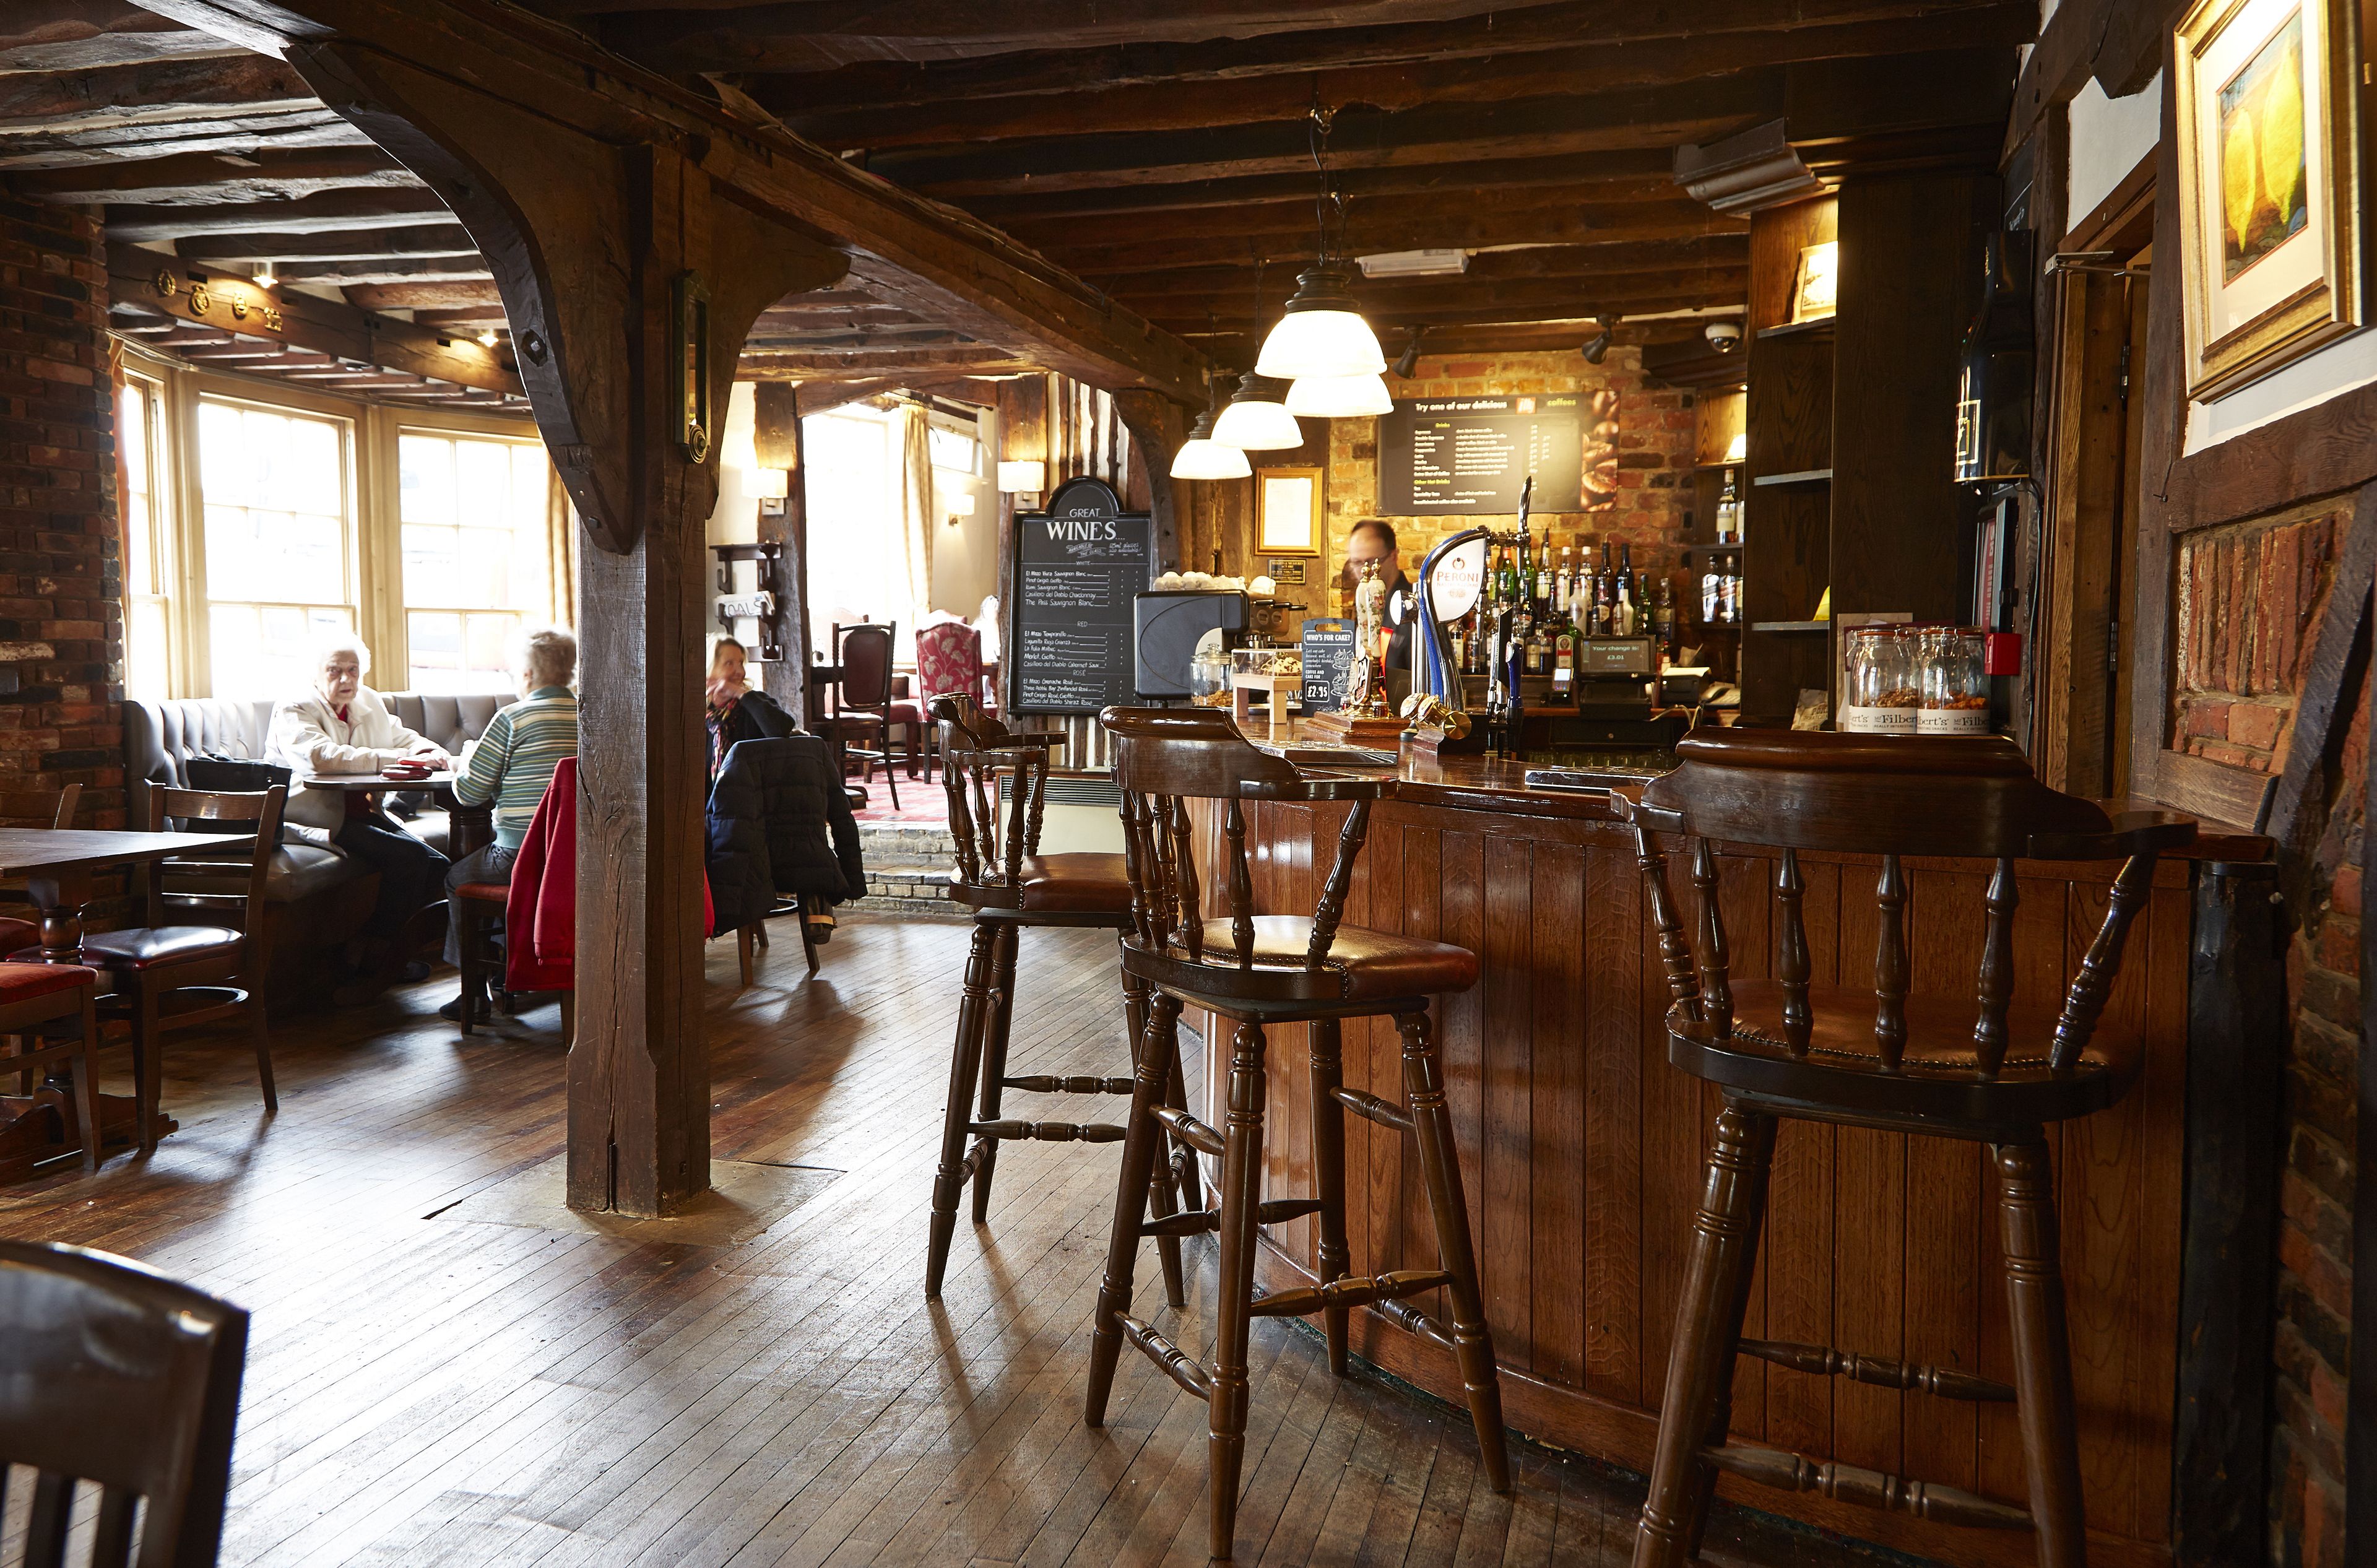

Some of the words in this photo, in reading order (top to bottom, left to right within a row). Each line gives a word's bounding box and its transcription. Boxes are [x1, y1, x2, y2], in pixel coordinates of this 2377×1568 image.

[1415, 403, 1428, 413] Try
[1446, 401, 1456, 410] of
[1472, 401, 1507, 409] delicious
[1518, 398, 1535, 414] illy
[1547, 398, 1576, 406] coffees
[1070, 508, 1101, 518] GREAT
[1437, 571, 1478, 582] PERONI
[1050, 600, 1076, 609] Sauvignon
